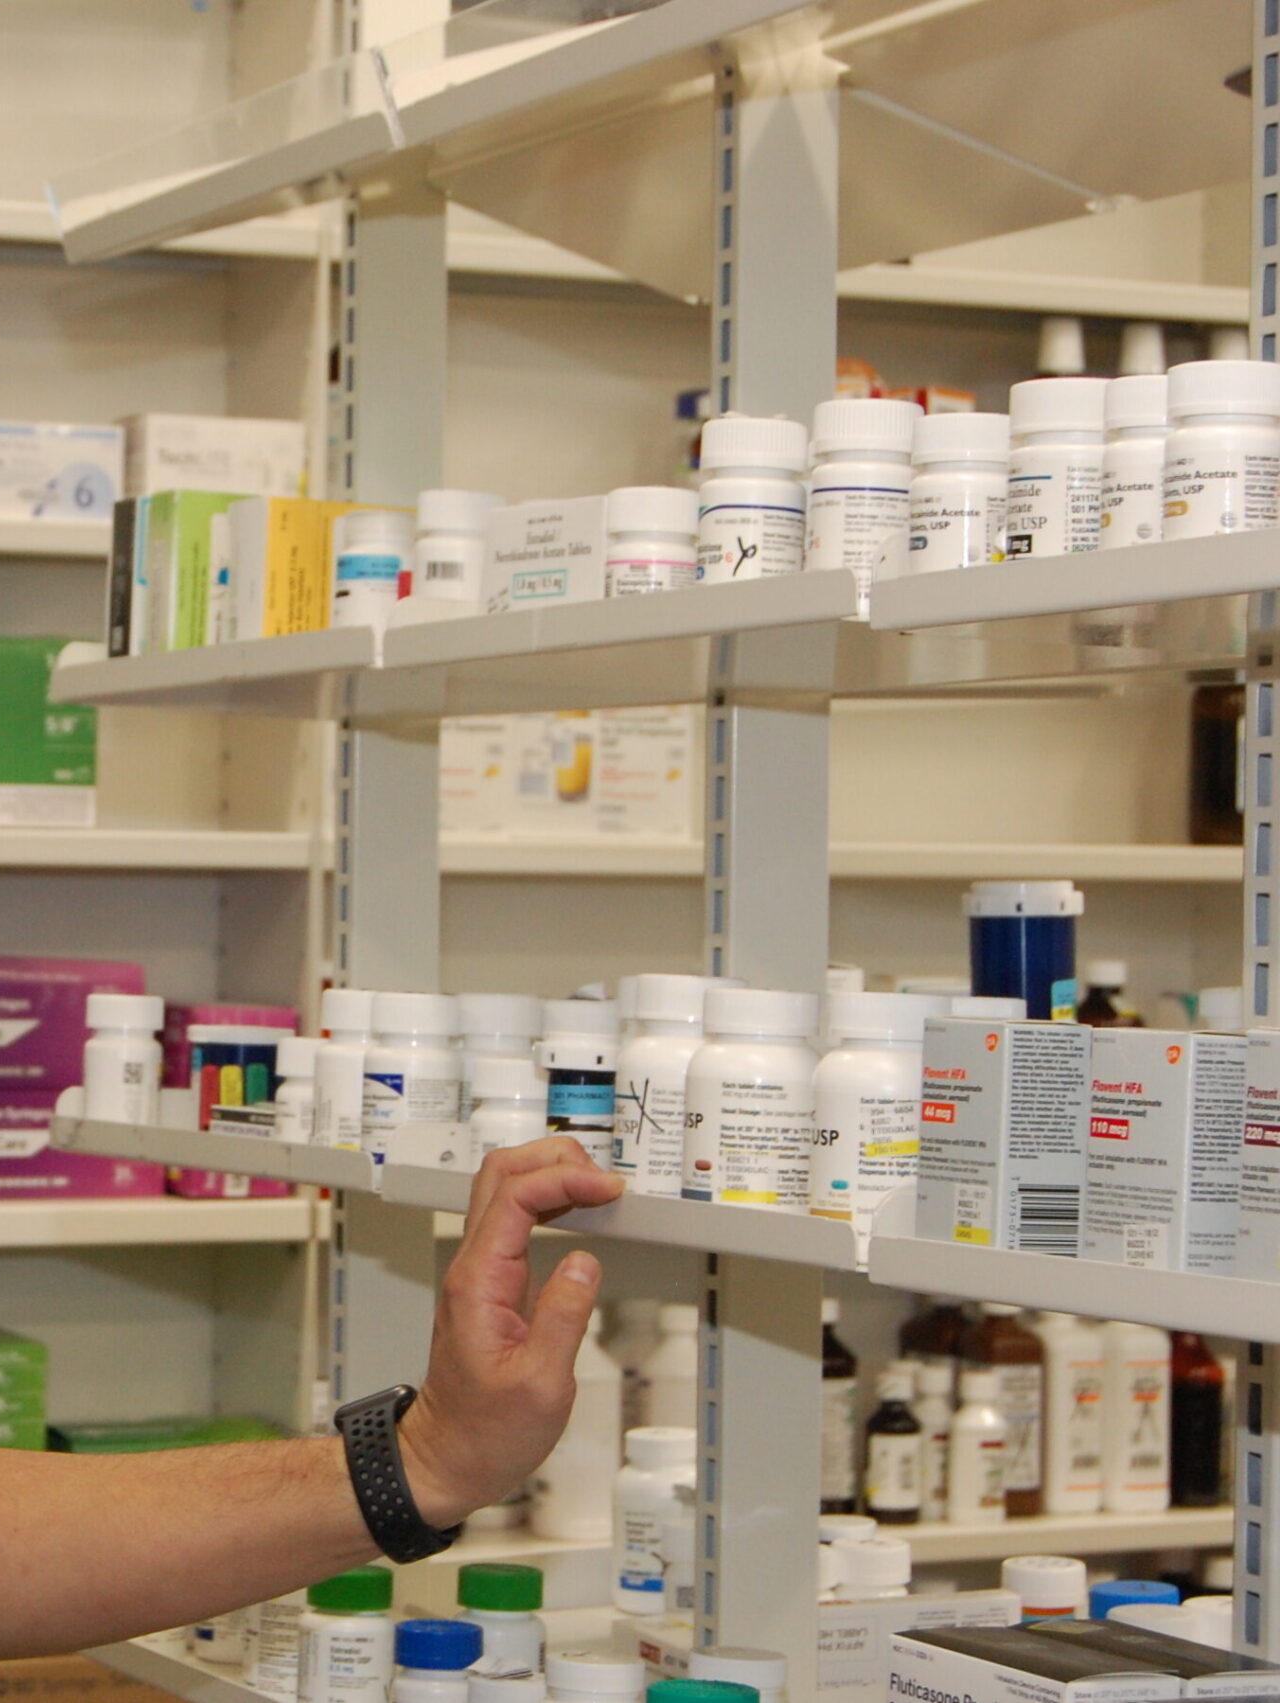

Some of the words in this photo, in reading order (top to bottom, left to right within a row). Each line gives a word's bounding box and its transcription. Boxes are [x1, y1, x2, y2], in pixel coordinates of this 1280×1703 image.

[1194, 471, 1237, 479] Acetate
[1116, 482, 1154, 492] Acetate
[1183, 484, 1204, 494] USP
[1107, 497, 1124, 507] USP
[941, 508, 981, 517] Acetate
[931, 521, 950, 531] USP
[1021, 517, 1048, 530] USP
[923, 1066, 948, 1079] Flovent
[950, 1068, 966, 1080] HFA
[1091, 1079, 1122, 1093] Flovent
[1124, 1081, 1142, 1094] HFA
[1248, 1086, 1278, 1100] Flovent
[924, 1106, 935, 1117] 44
[936, 1108, 952, 1120] mcg
[1092, 1121, 1107, 1134] 110
[1108, 1124, 1128, 1137] mcg
[1245, 1126, 1262, 1140] 220
[812, 1129, 839, 1146] USP
[890, 1673, 958, 1703] Fluticasone
